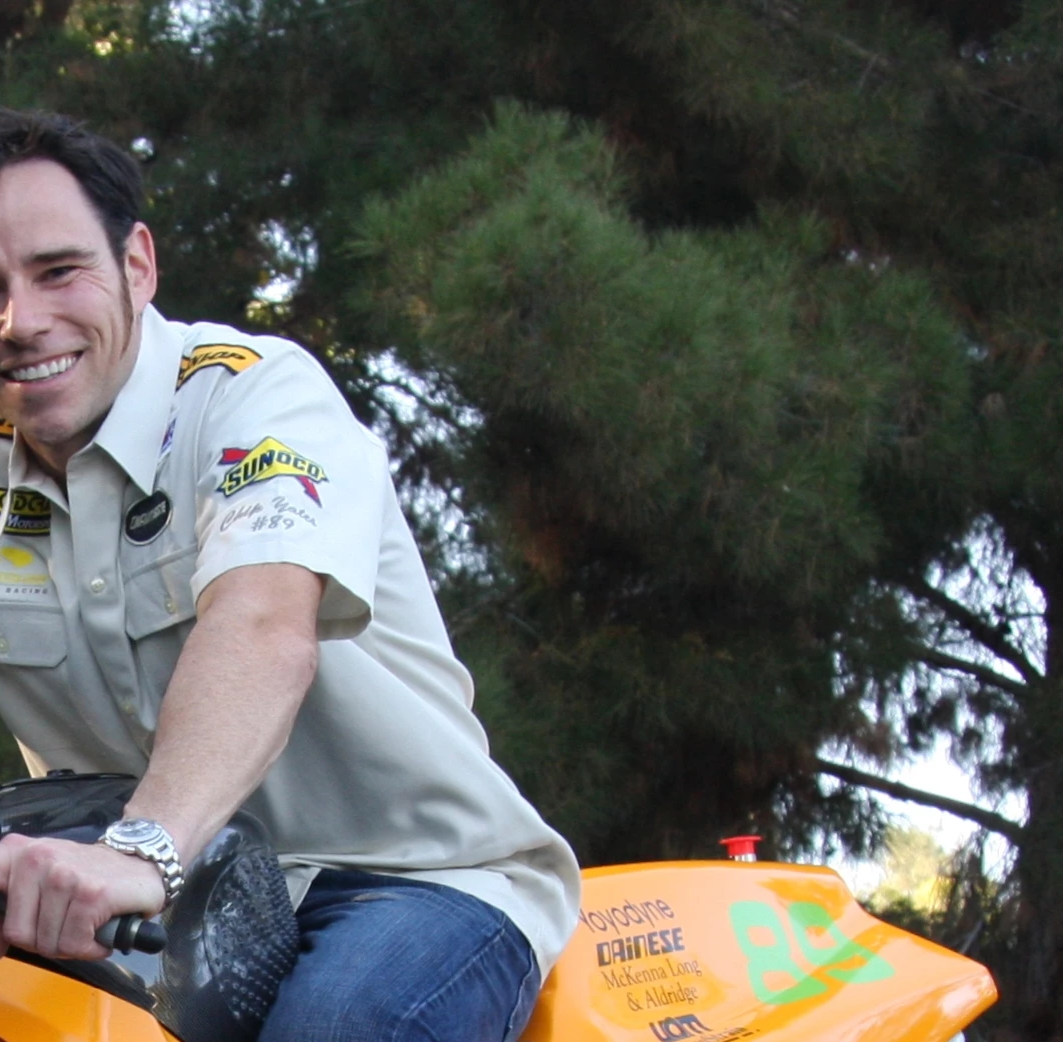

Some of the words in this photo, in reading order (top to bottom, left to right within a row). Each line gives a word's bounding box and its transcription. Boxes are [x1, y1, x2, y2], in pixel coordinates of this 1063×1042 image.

[228, 450, 320, 491] SUNOCO
[251, 515, 294, 532] #89
[5, 586, 49, 595] RACING
[728, 900, 896, 1006] 89
[601, 966, 668, 992] McKenna
[665, 957, 703, 983] Long
[627, 992, 643, 1012] &
[645, 985, 699, 1010] Aldridge
